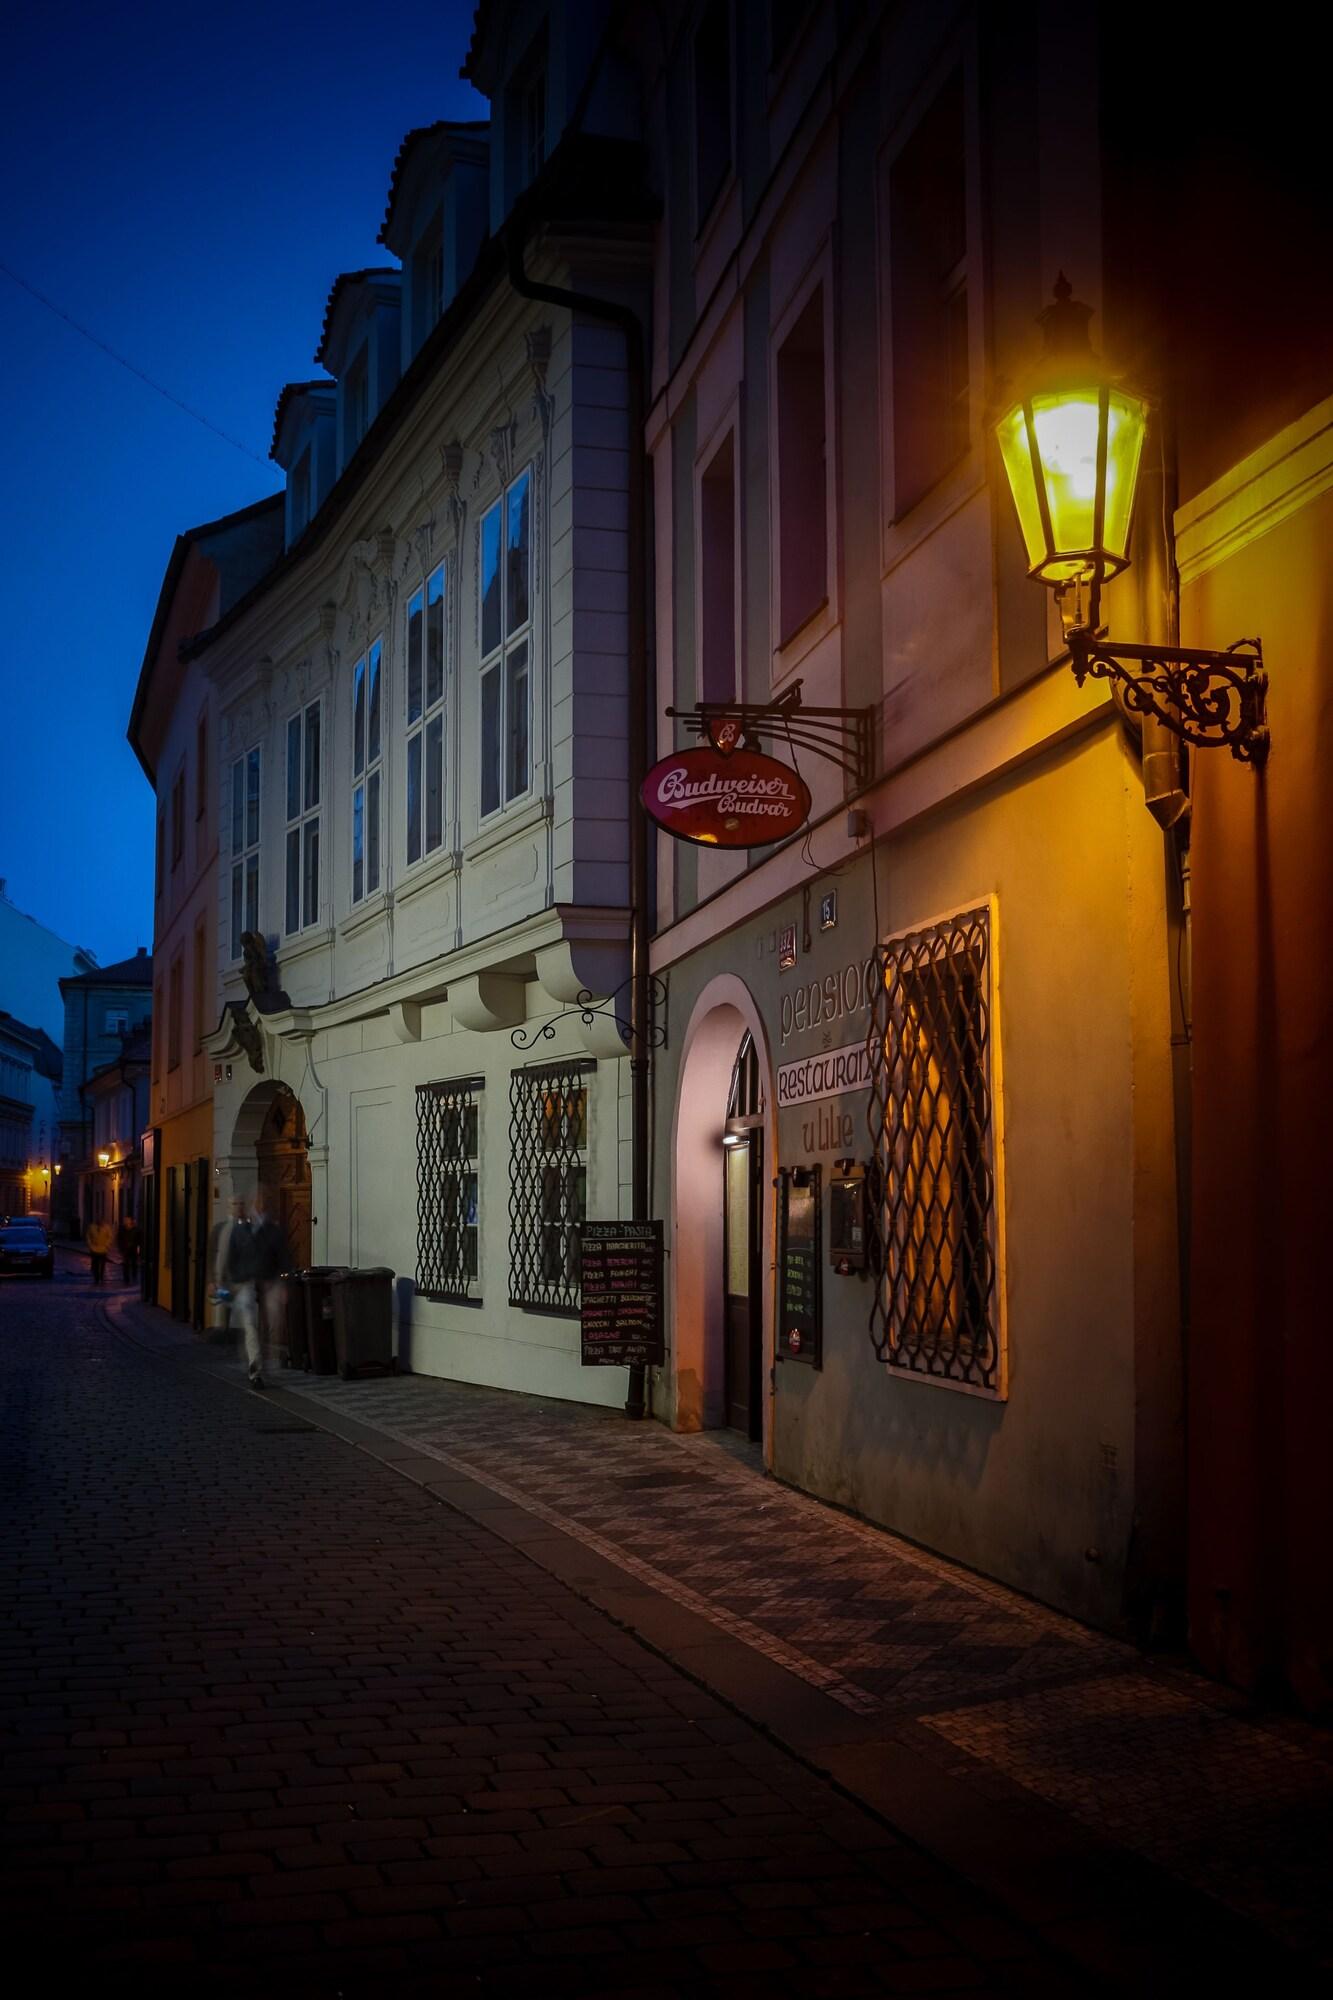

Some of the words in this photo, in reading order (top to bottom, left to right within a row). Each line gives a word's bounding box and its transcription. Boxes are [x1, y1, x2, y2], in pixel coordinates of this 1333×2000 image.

[657, 768, 796, 803] Budweiser
[717, 792, 793, 817] Budvar
[781, 958, 878, 1046] pension
[585, 1226, 617, 1237] PIZZA
[624, 1226, 652, 1237] PASTA
